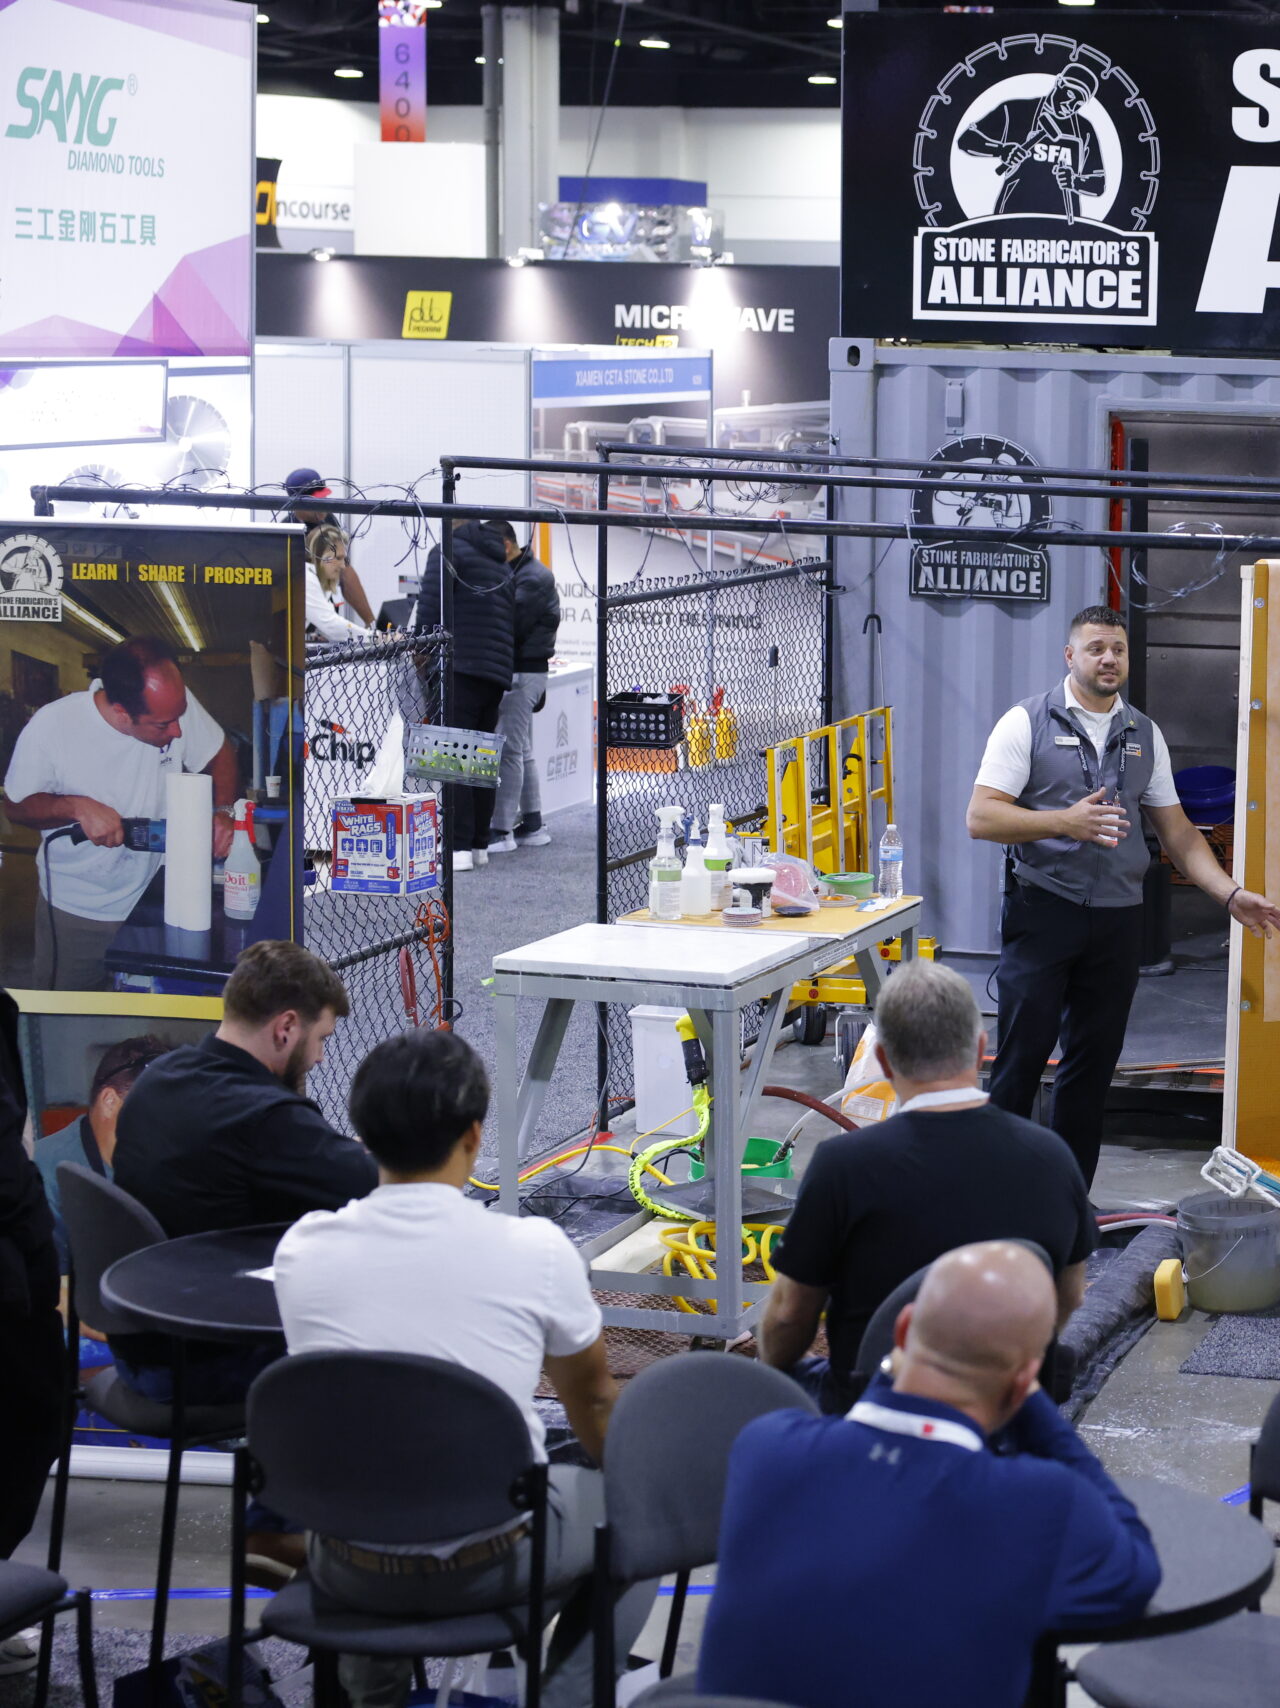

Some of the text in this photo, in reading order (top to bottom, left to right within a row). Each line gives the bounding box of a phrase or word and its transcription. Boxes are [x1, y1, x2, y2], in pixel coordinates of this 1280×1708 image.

[394, 43, 411, 142] 6400
[5, 66, 125, 147] SANG
[67, 150, 165, 178] DIAMOND TOOLS
[1033, 144, 1073, 166] SFA
[276, 199, 351, 221] ncourse
[934, 237, 996, 262] STONE
[927, 265, 1142, 309] ALLIANCE
[614, 303, 796, 333] MICRAVE
[576, 369, 603, 387] XIAMEN
[604, 368, 623, 385] CETA
[624, 368, 648, 384] STONE
[922, 550, 958, 565] STONE
[72, 562, 273, 585] LEARN SHARE PROSPER
[918, 566, 1042, 594] ALLIANCE
[0, 596, 14, 605] TONE
[556, 583, 596, 599] NIQU
[339, 813, 376, 827] WHITE
[351, 822, 382, 836] RAGS
